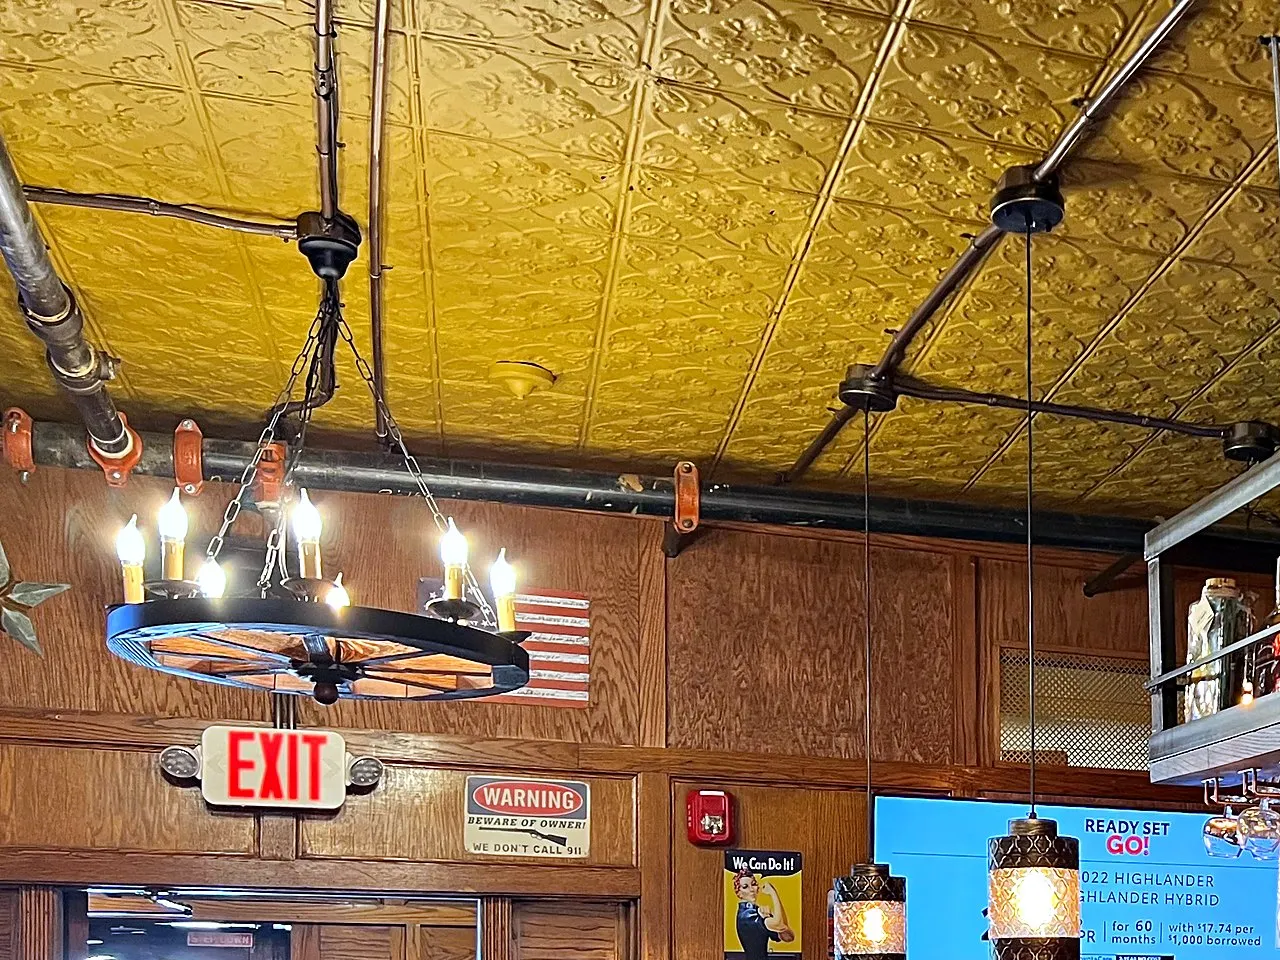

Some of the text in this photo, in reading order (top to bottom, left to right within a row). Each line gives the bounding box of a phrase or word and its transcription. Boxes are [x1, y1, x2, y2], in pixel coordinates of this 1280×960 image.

[228, 730, 328, 801] EXIT
[483, 787, 574, 810] WARNING
[468, 816, 586, 829] BEWARE OF OWNER!
[1085, 819, 1170, 836] READY SET
[473, 843, 581, 855] WE DON'T CALL 911
[1106, 835, 1150, 856] GO!
[733, 856, 794, 871] We Can Do It!
[1079, 871, 1214, 888] 022 HIGHLANDER
[1079, 890, 1220, 906] GHLANDER HYBRID
[1112, 920, 1152, 932] for 60
[1169, 922, 1254, 935] with $17.74 per
[1079, 930, 1096, 943] PR
[1112, 934, 1156, 944] months
[1168, 935, 1261, 946] $1,000 borrowed
